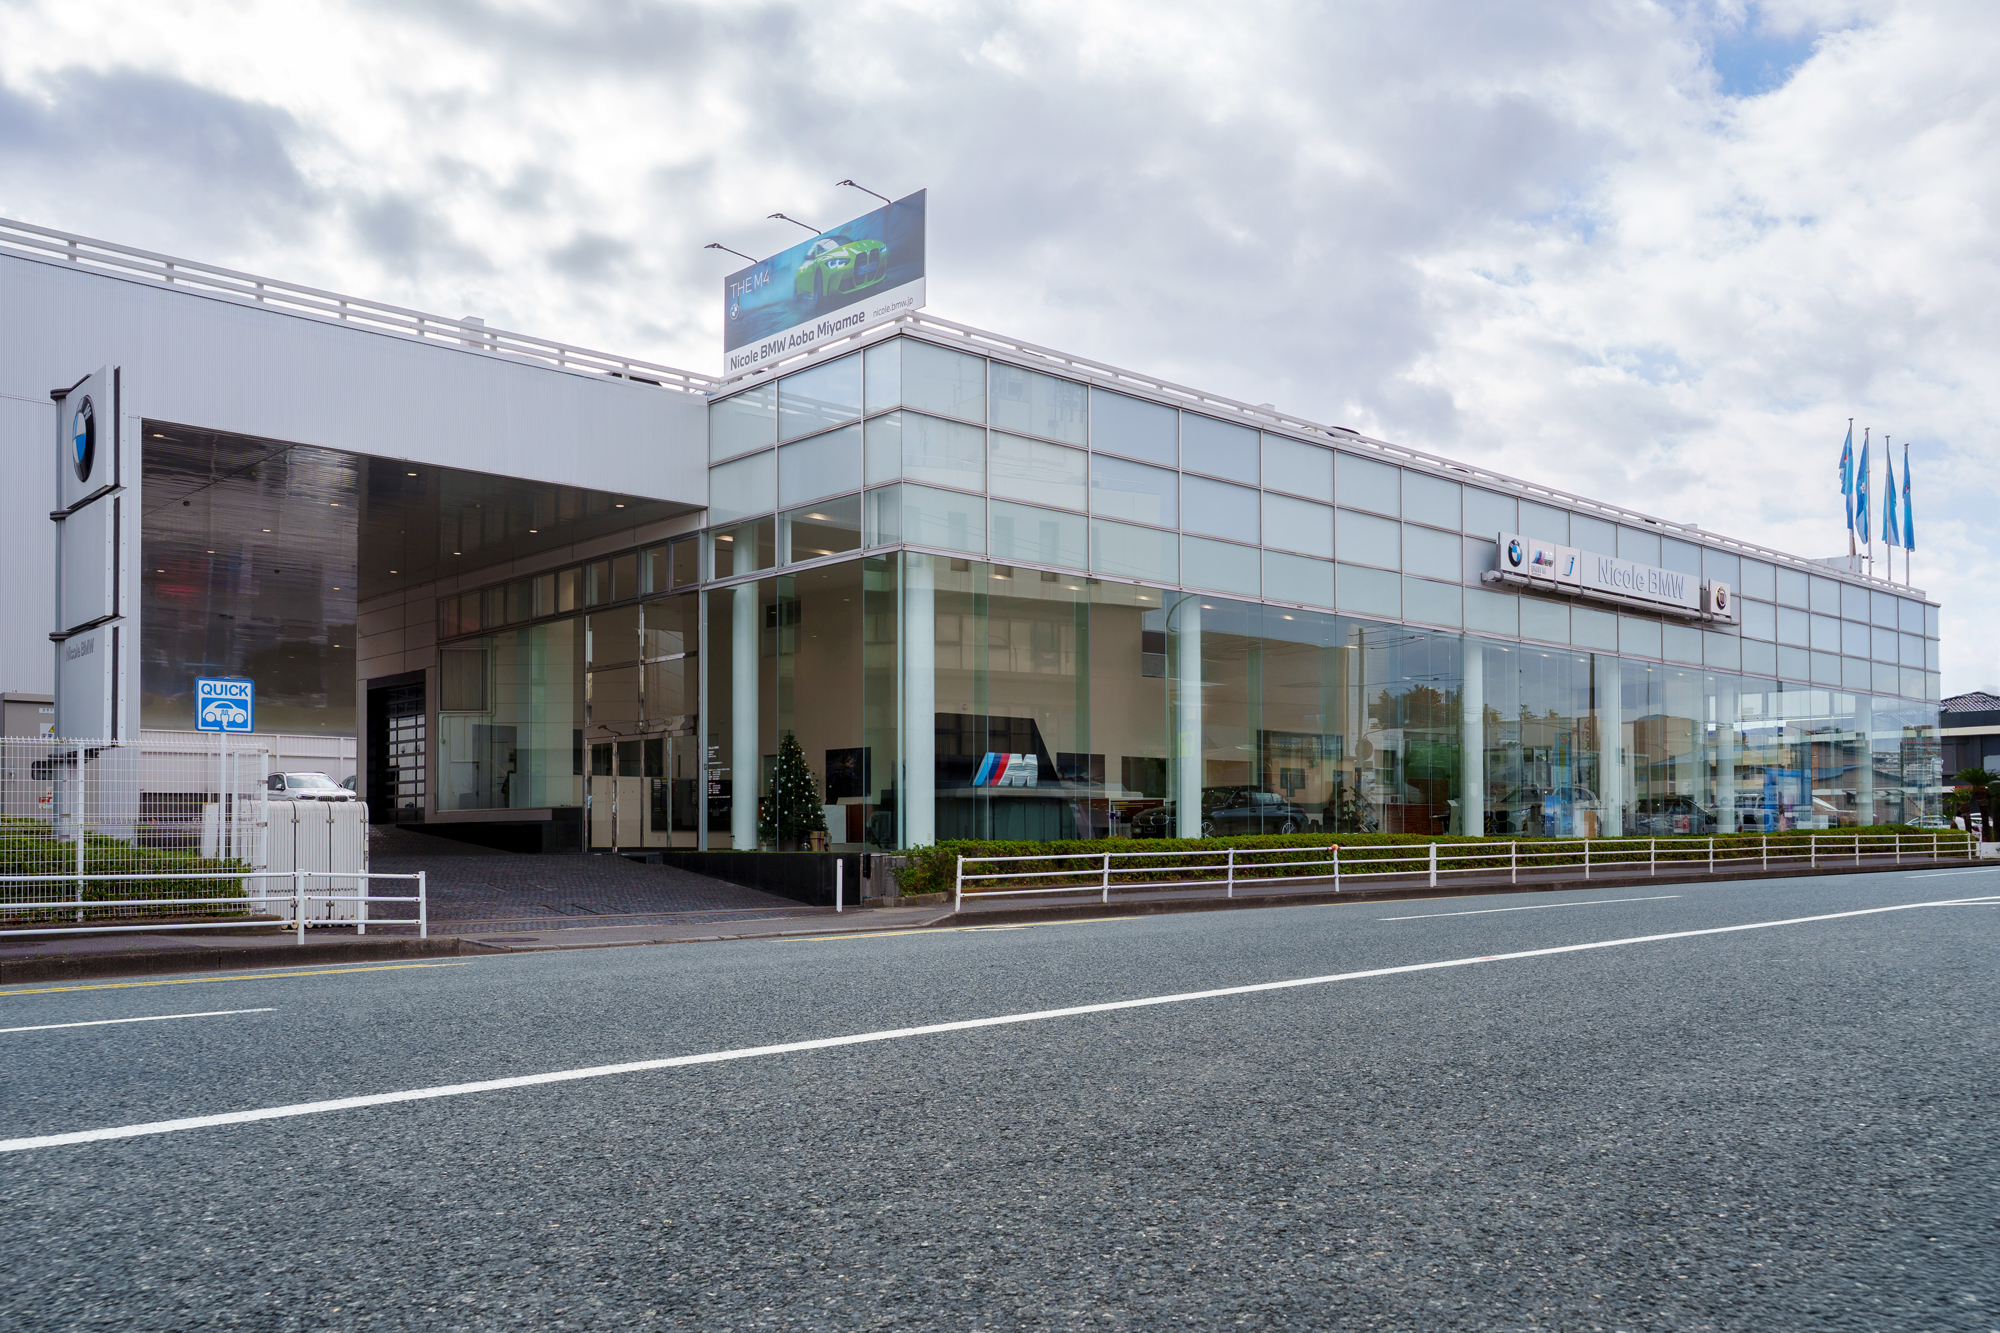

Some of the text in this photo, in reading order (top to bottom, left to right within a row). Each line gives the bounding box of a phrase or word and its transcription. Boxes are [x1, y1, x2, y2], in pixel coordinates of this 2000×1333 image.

[730, 269, 770, 299] THE M4
[873, 296, 914, 318] nicole.bmw.jp
[730, 311, 865, 371] Nicole BMW Aoba Miyamae
[1598, 557, 1685, 600] Nicole BMW
[81, 637, 95, 657] BMW
[201, 683, 249, 697] QUICK
